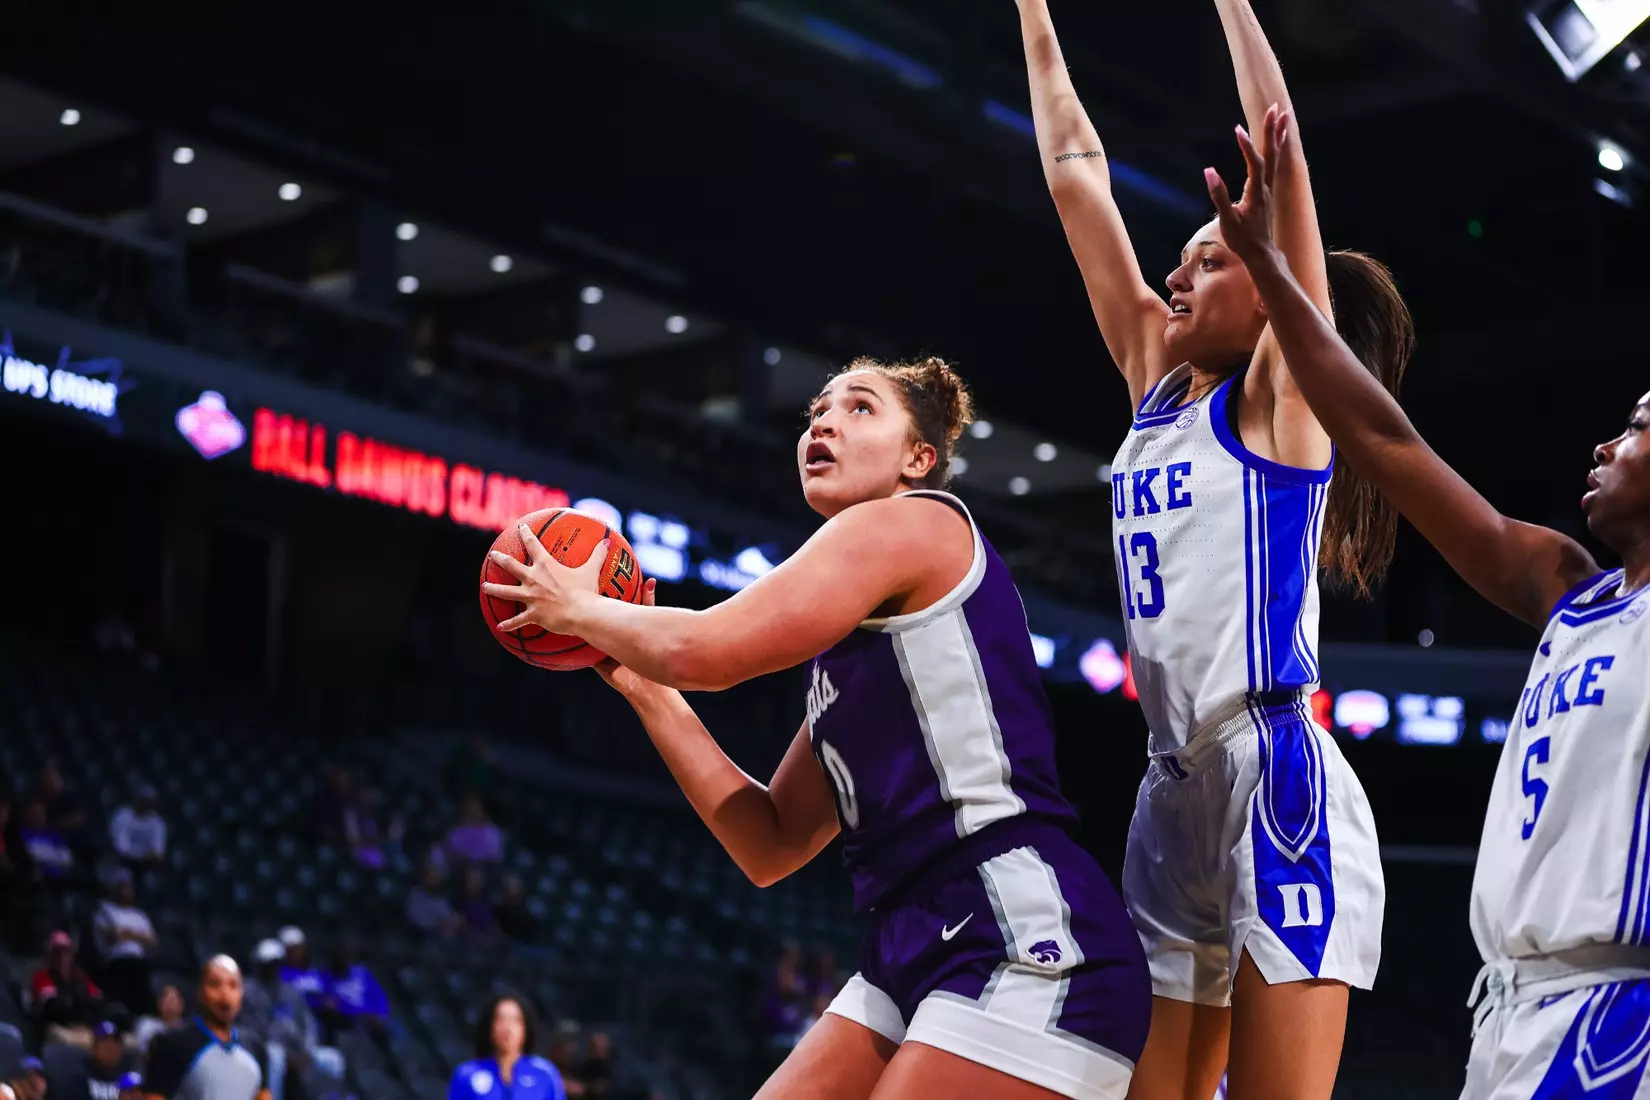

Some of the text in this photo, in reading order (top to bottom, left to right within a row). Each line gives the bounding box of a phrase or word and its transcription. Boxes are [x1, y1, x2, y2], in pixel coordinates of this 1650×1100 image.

[252, 407, 330, 488] BALL
[1112, 461, 1192, 520] UKE
[1119, 531, 1166, 620] 13
[1521, 736, 1551, 841] 5
[1277, 883, 1324, 928] D
